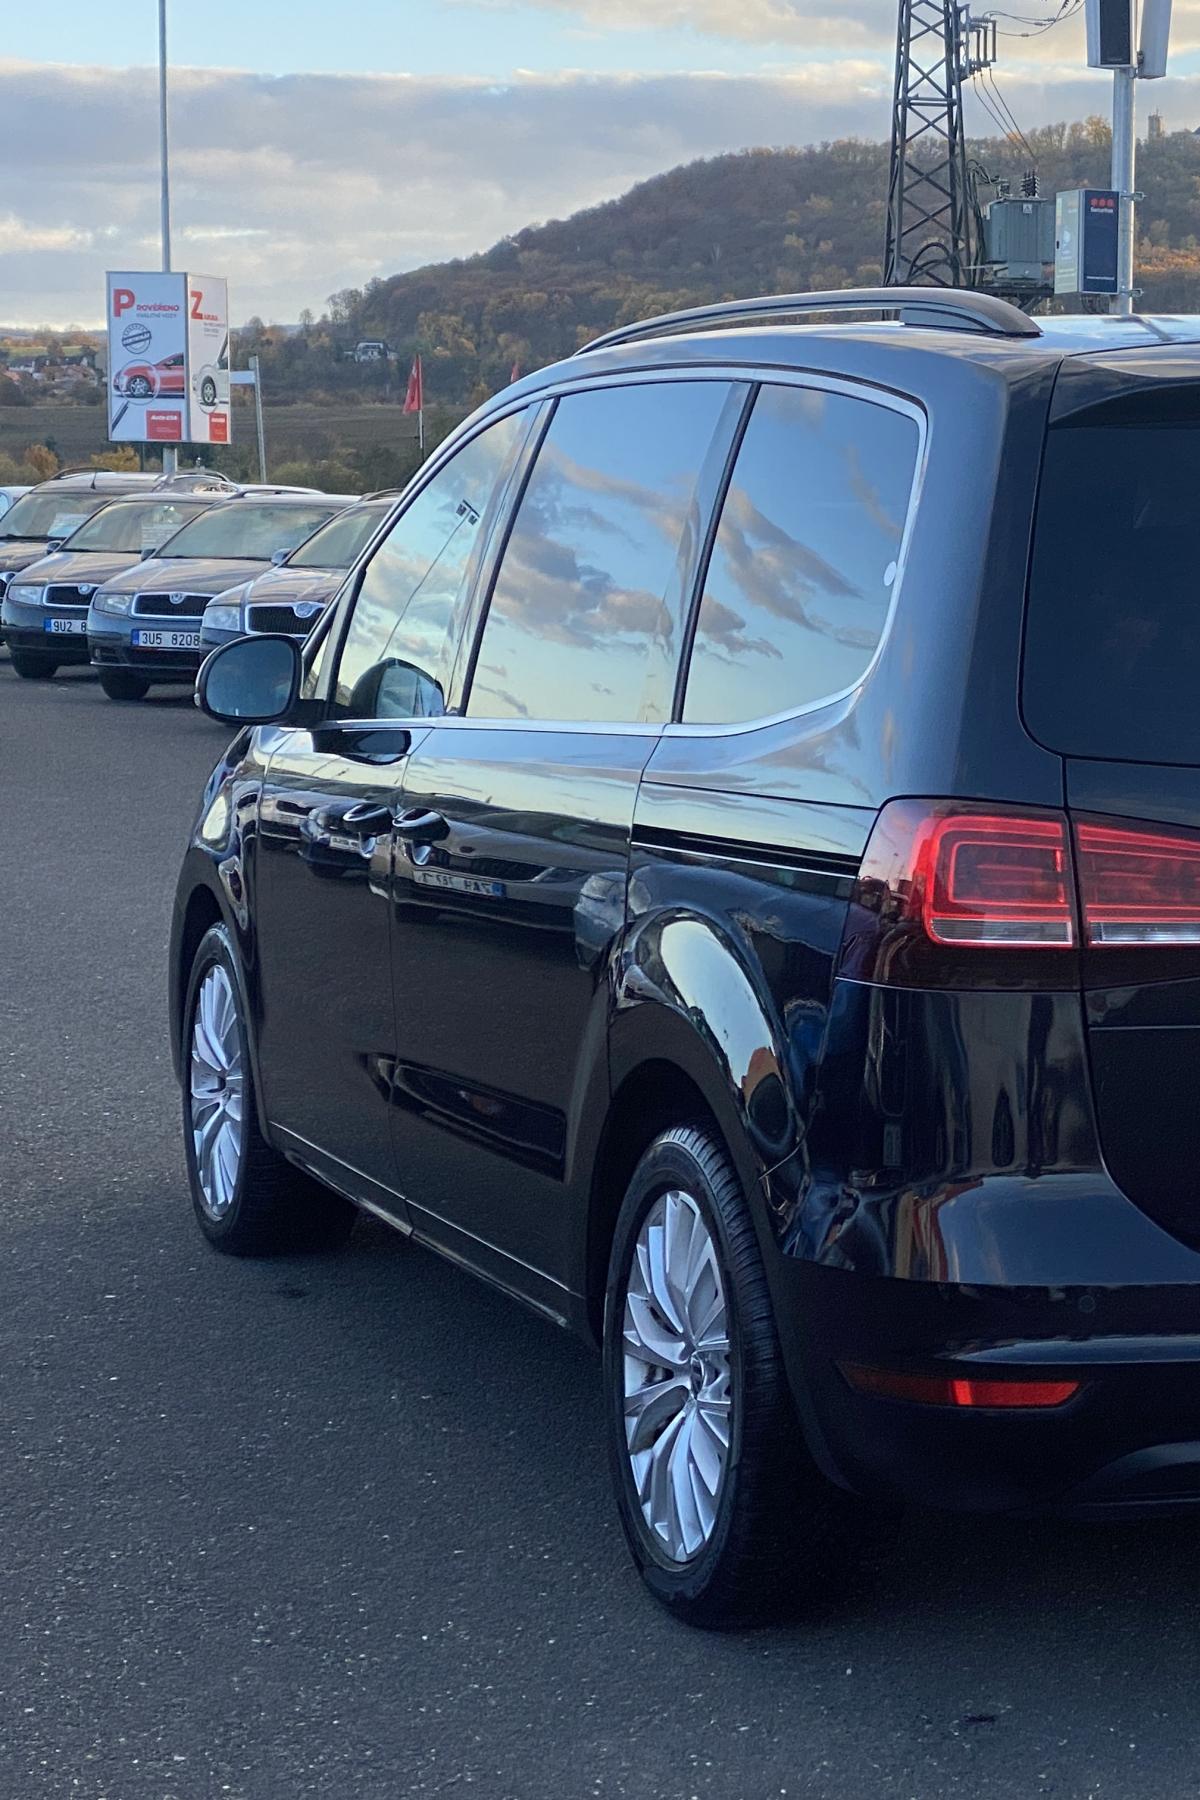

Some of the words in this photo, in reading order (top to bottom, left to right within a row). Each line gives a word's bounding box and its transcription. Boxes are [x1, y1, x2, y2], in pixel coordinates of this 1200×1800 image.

[53, 621, 73, 632] 9U2
[141, 632, 163, 644] 3U5
[171, 634, 200, 646] 8208
